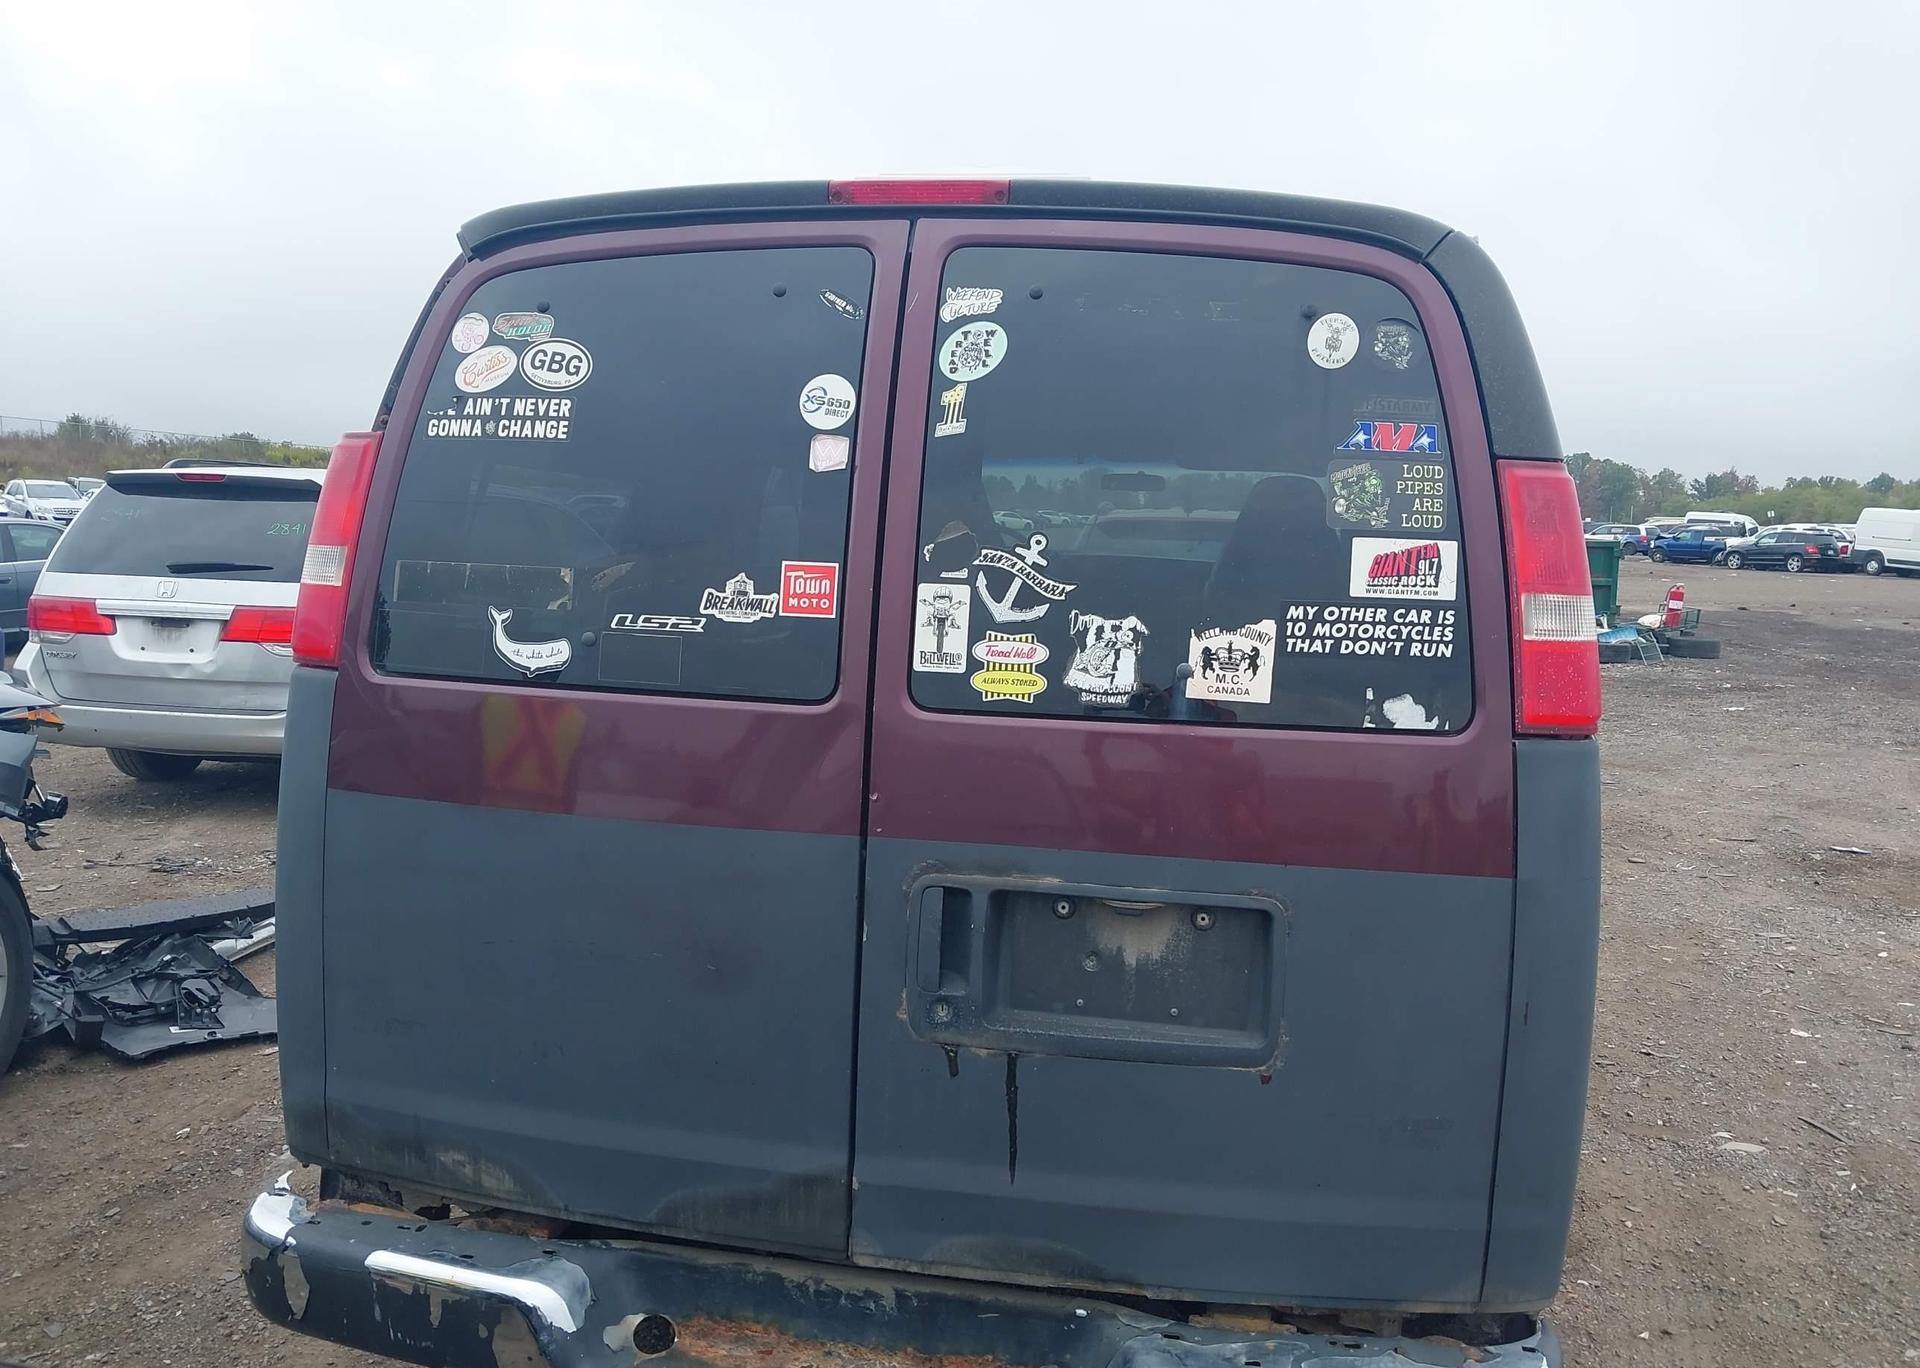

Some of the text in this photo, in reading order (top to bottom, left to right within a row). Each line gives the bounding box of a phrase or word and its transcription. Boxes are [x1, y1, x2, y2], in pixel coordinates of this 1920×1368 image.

[947, 289, 1002, 301] WEEKEND
[941, 302, 997, 320] CULTURE
[461, 351, 511, 388] Curtiss
[530, 348, 583, 378] GBG
[463, 397, 511, 416] AIN'T
[512, 398, 572, 417] NEVER
[824, 407, 849, 419] DIRECT
[427, 418, 569, 439] GONNA CHANGE
[1337, 421, 1441, 454] AMA
[1402, 464, 1444, 479] LOUD
[1396, 481, 1444, 495] PIPES
[1412, 498, 1443, 512] ARE
[266, 521, 307, 536] 2841
[1401, 513, 1443, 528] LOUD
[1367, 542, 1439, 579] GIANT FM
[1417, 558, 1439, 575] 91.7
[786, 570, 831, 595] Town
[979, 552, 1066, 598] SANTA BARBARA
[1366, 575, 1437, 587] CLASSIC ROCK
[1365, 588, 1439, 597] WWW.GIANTFM.COM
[703, 591, 776, 614] BREAKWALL
[788, 597, 830, 609] MOTO
[1286, 605, 1456, 625] MY OTHER CAR IS
[1239, 626, 1274, 647] COUNTY
[1286, 621, 1454, 641] 10 MOTORCYCLES
[1286, 638, 1453, 658] THAT DON'T RUN
[981, 677, 1038, 687] ALWAYS STOKED
[1216, 673, 1243, 686] M.C.
[1080, 691, 1129, 704] SPEEDWAY
[1207, 685, 1250, 697] CANADA
